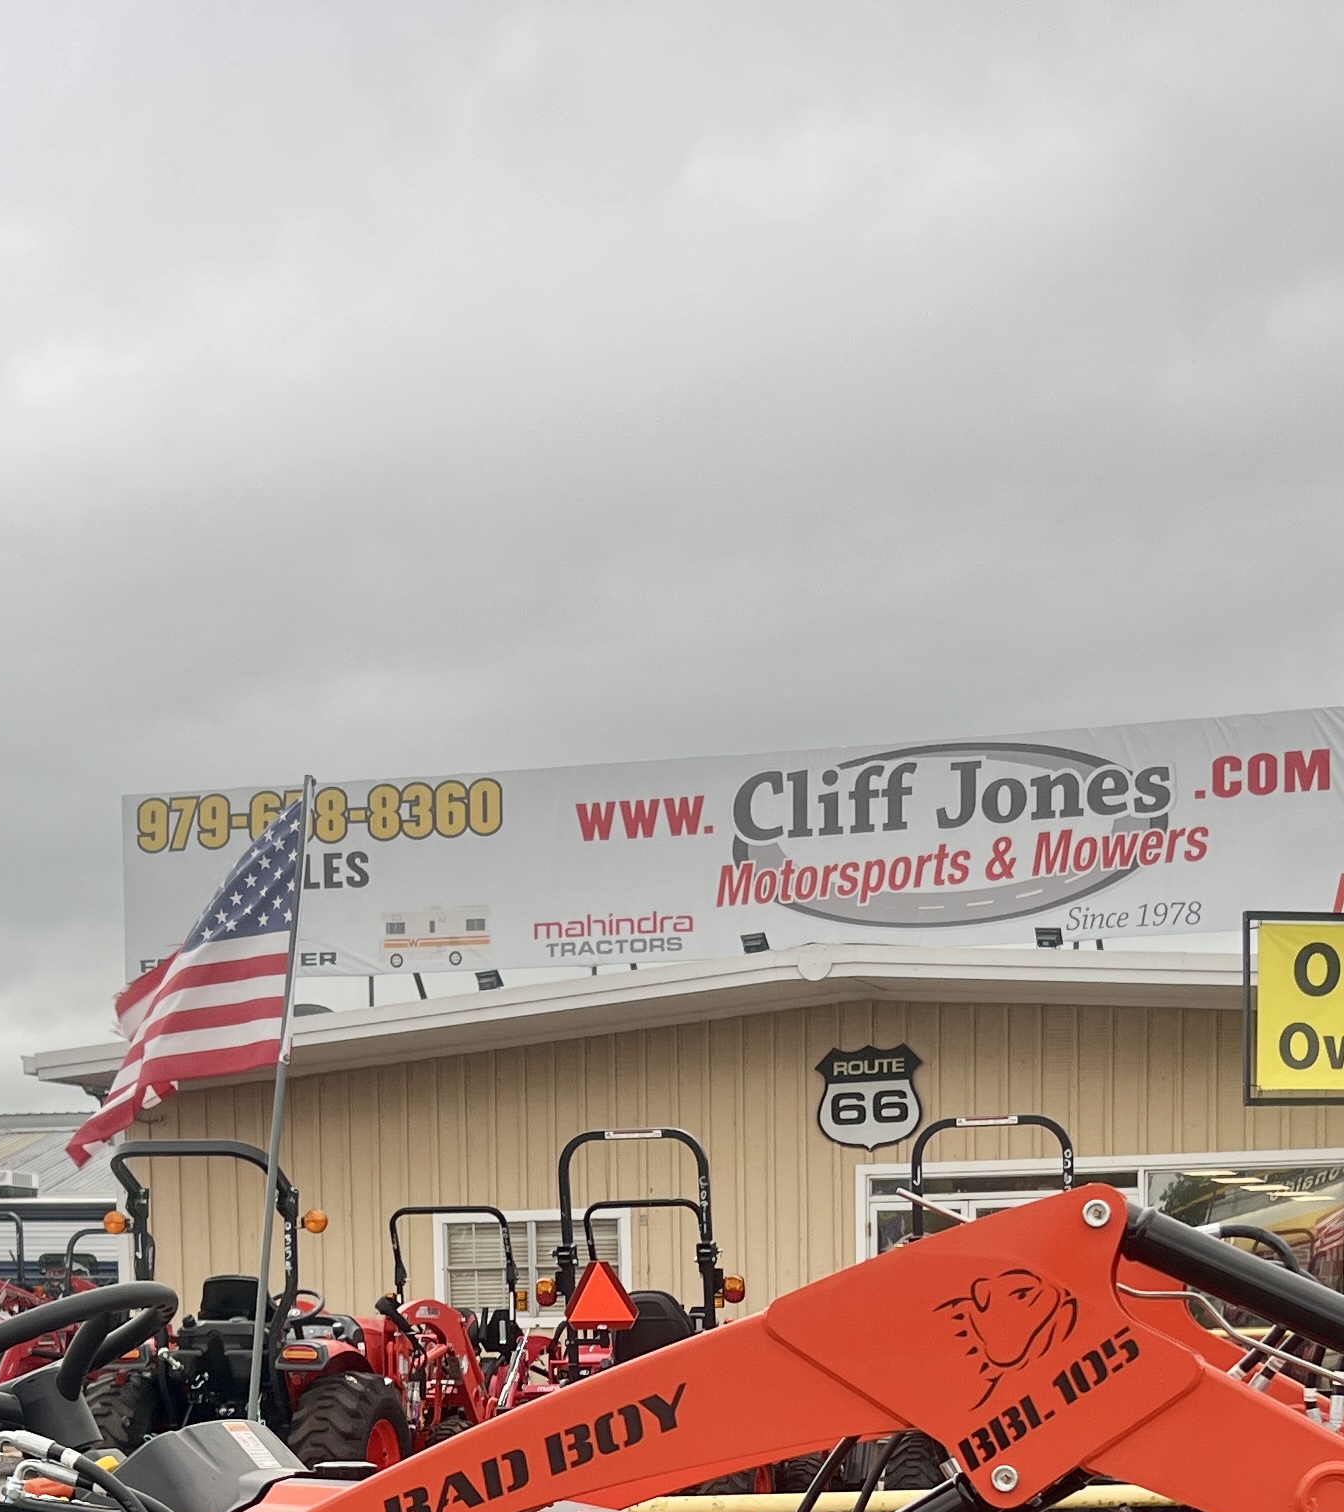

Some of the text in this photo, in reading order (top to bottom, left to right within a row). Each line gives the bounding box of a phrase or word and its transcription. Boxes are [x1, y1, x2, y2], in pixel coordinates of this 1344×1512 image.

[576, 749, 1331, 842] WWW. Cliff Jones .COM
[137, 778, 503, 853] 979-68-8360
[302, 851, 369, 890] LES
[716, 826, 1210, 908] Motorsports & Mowers
[534, 911, 694, 940] mahindra
[1066, 901, 1202, 932] Since 1978
[546, 936, 683, 958] TRACTORS
[833, 1057, 905, 1076] ROUTE
[829, 1089, 910, 1127] 66
[958, 1326, 1141, 1472] BBL 105
[544, 1382, 687, 1474] BOY
